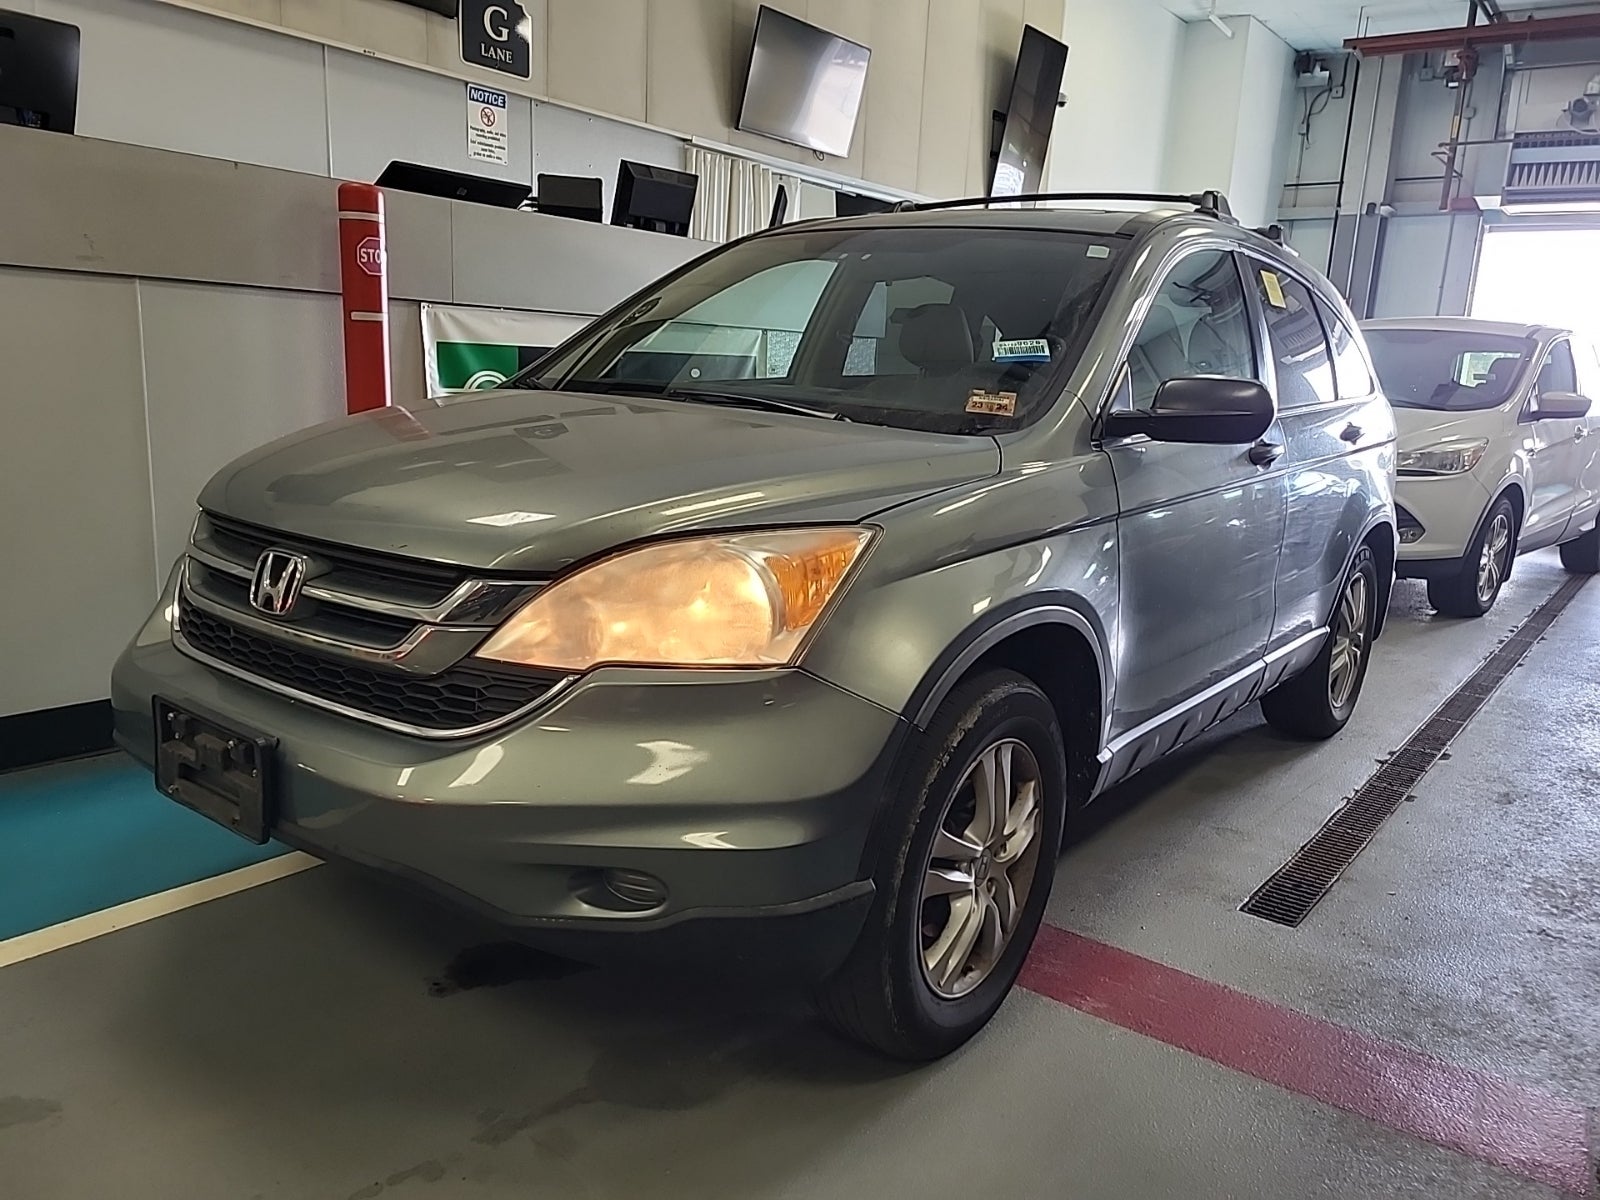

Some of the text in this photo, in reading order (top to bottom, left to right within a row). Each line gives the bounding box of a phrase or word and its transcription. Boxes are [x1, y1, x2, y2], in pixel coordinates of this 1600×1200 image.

[483, 5, 510, 42] G
[480, 43, 513, 64] LANE
[470, 88, 505, 107] NOTICE
[360, 248, 382, 264] STO
